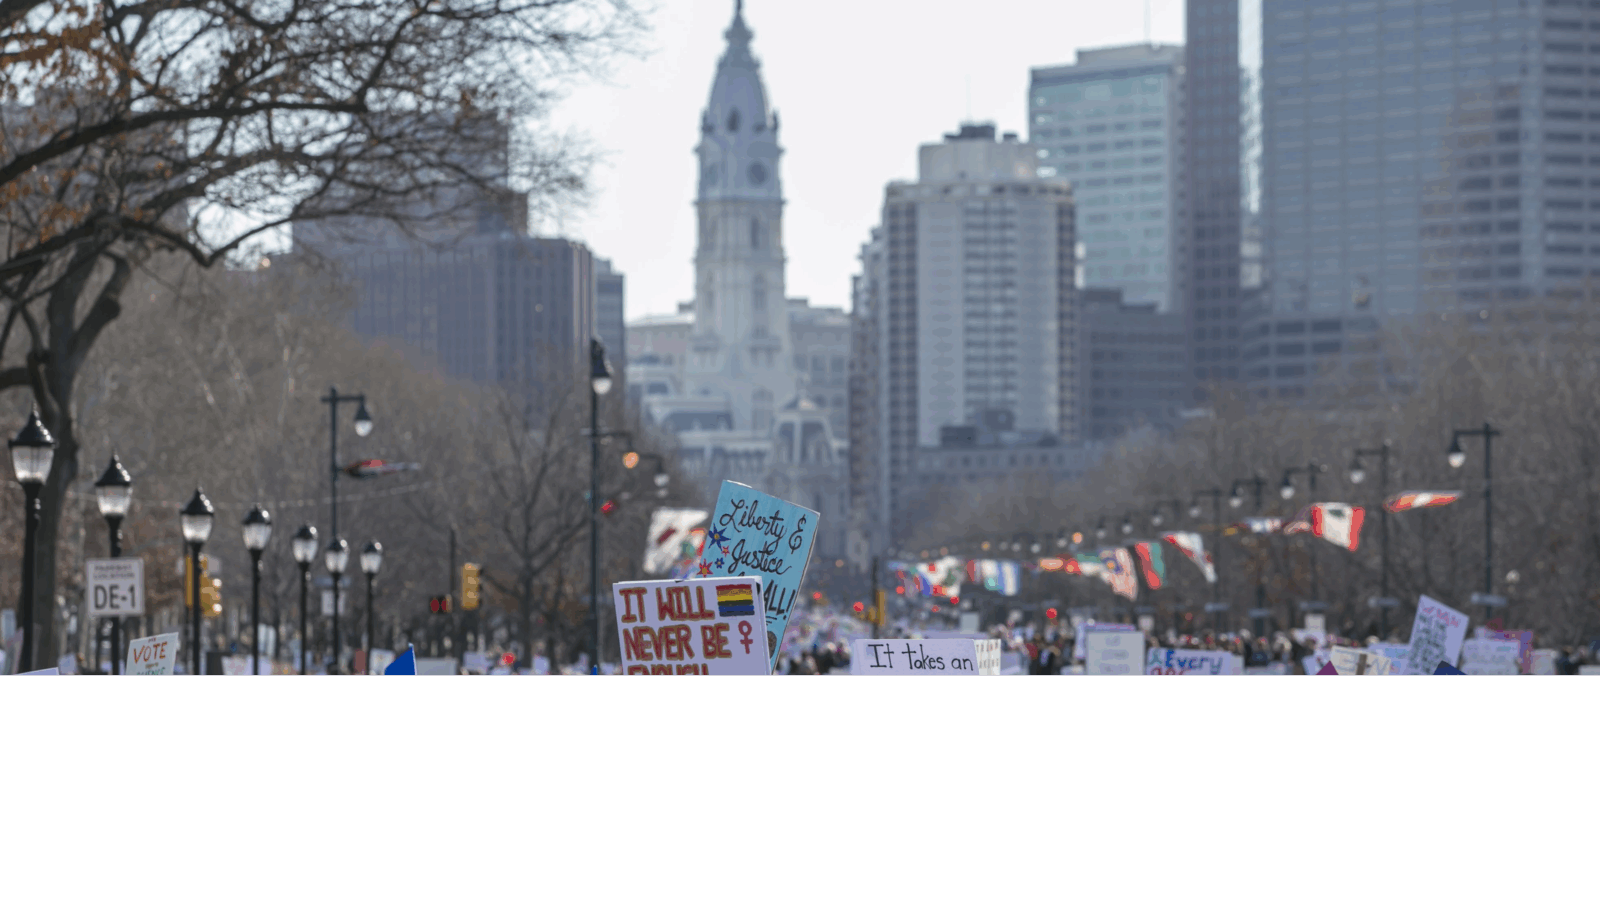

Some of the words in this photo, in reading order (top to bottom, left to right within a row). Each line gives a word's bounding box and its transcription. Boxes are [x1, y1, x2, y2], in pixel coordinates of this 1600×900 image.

[720, 499, 787, 555] Liberty
[788, 513, 807, 555] &
[727, 538, 792, 575] Justice
[93, 583, 136, 611] DE-1
[619, 587, 647, 623] IT
[655, 585, 715, 621] WILL
[133, 641, 168, 664] VOTE
[622, 624, 695, 661] NEVER
[700, 622, 732, 660] BE
[867, 643, 895, 669] It
[901, 642, 946, 670] takes
[951, 657, 974, 671] an
[1165, 648, 1223, 675] Every
